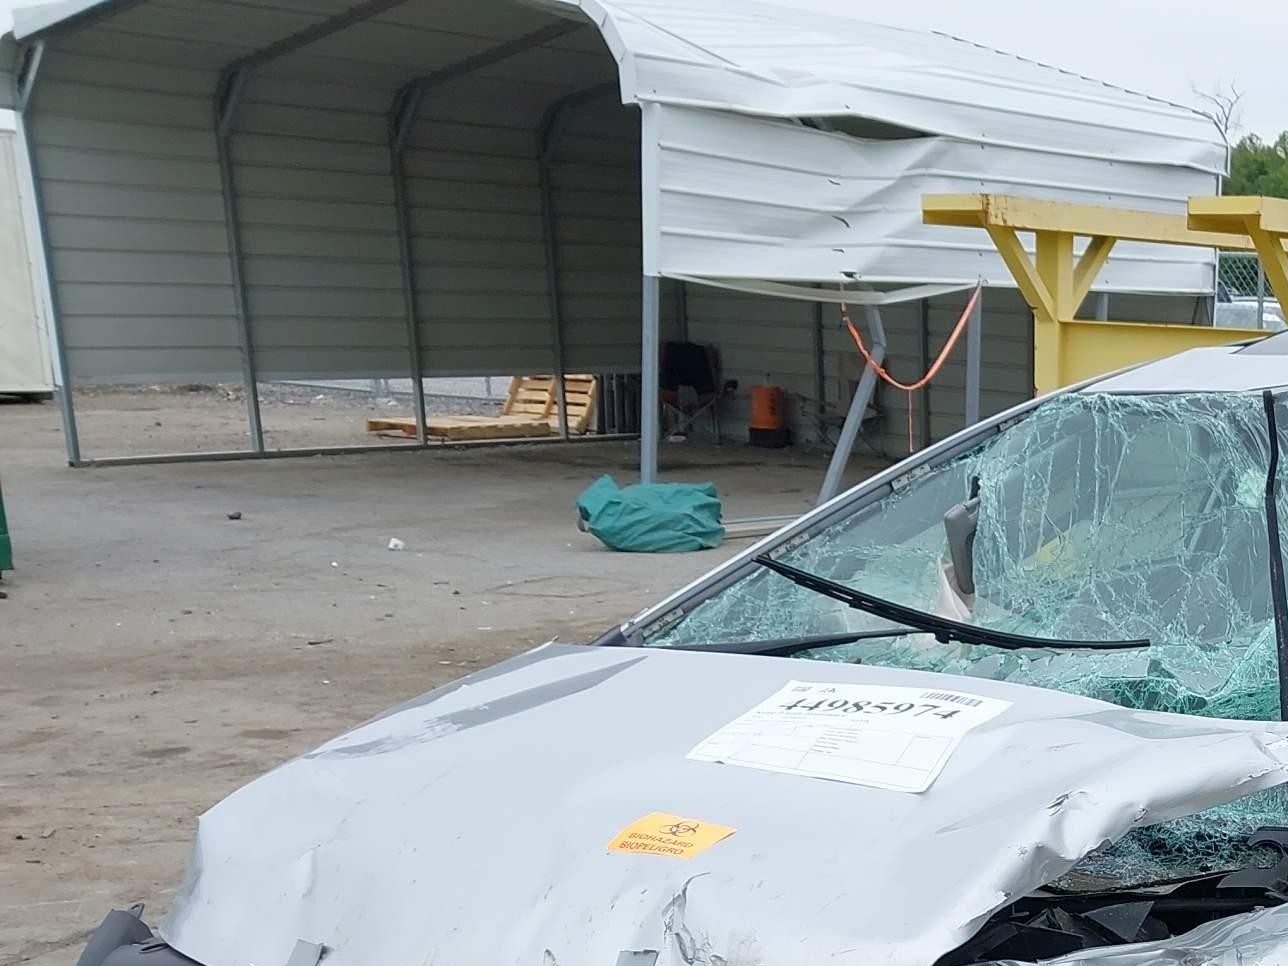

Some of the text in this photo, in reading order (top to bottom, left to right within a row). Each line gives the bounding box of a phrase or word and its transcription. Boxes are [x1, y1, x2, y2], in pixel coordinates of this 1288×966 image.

[778, 697, 961, 720] 44985974
[619, 840, 685, 855] BIOPELIGRO
[628, 832, 694, 848] BIOHAZARD
